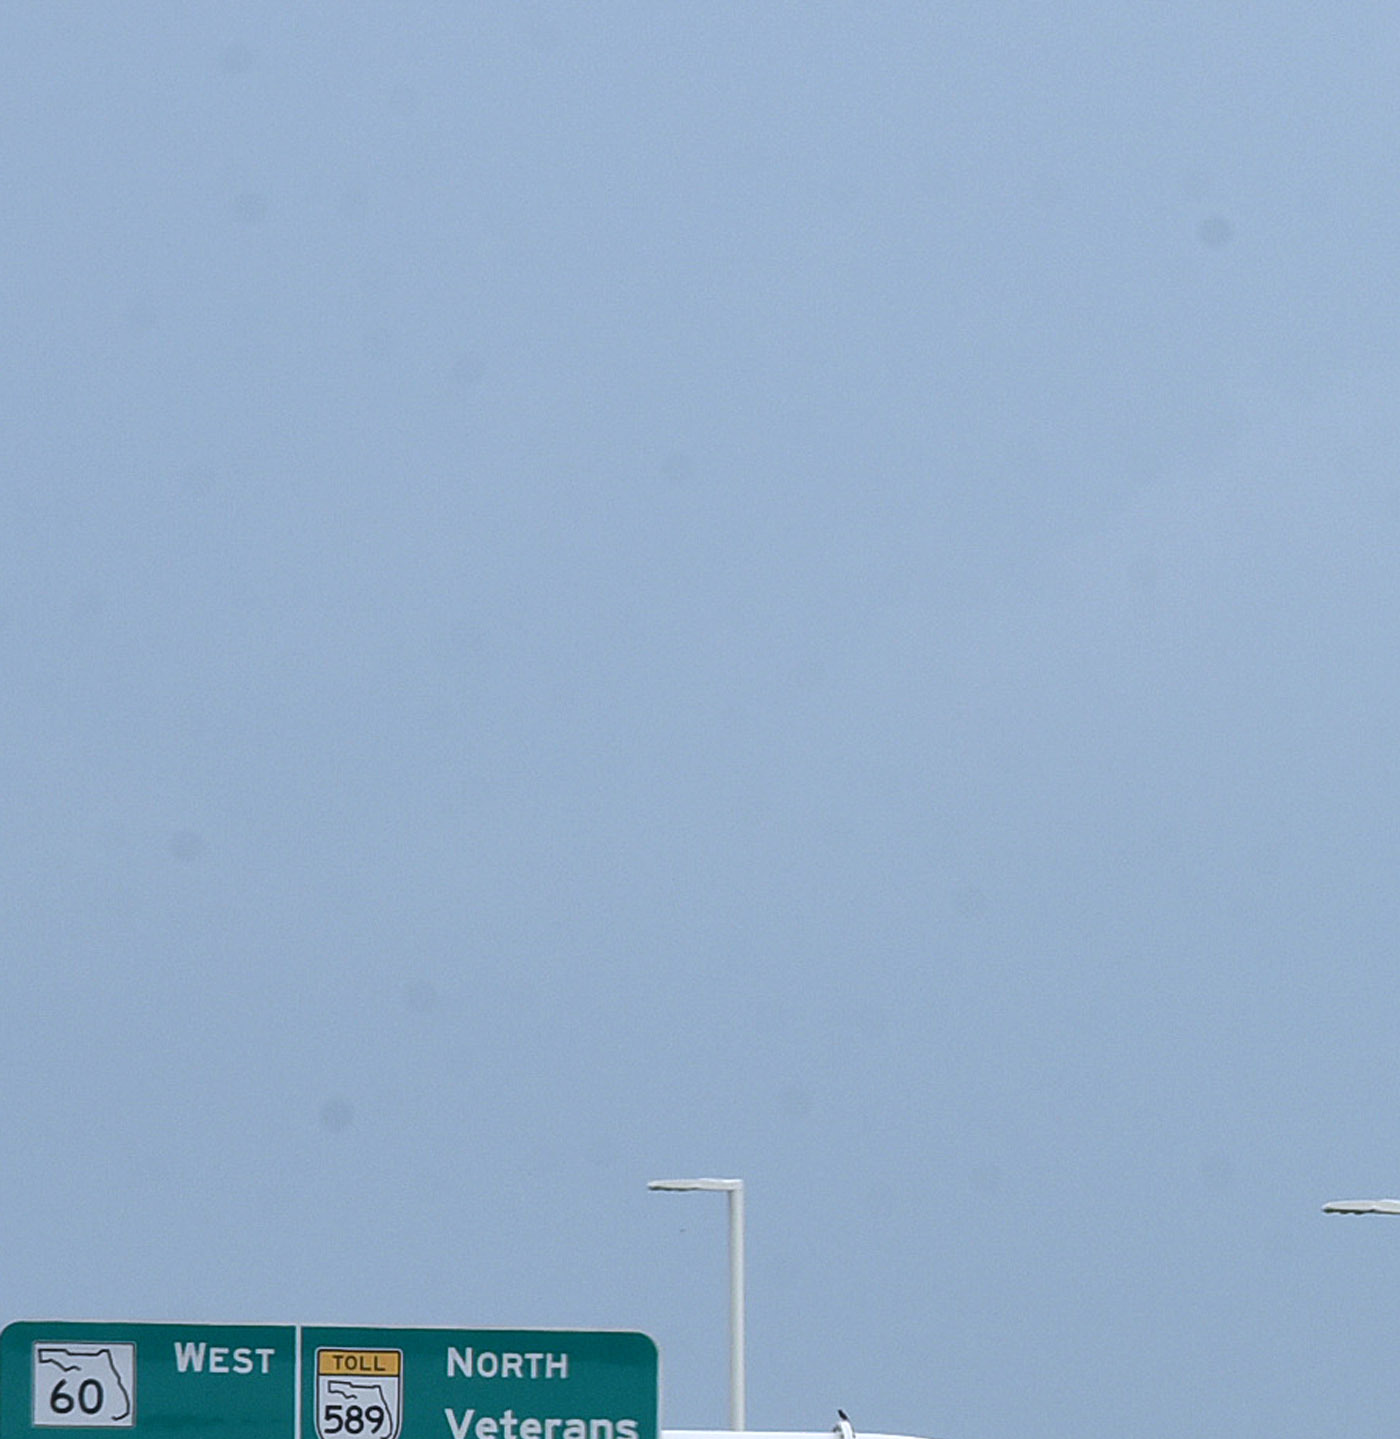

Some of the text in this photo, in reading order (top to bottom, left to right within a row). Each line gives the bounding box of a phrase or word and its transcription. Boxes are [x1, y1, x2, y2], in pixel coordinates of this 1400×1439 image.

[174, 1341, 275, 1375] WEST
[332, 1354, 387, 1372] TOLL
[446, 1346, 569, 1380] NORTH
[49, 1378, 104, 1415] 60
[324, 1405, 384, 1434] 589
